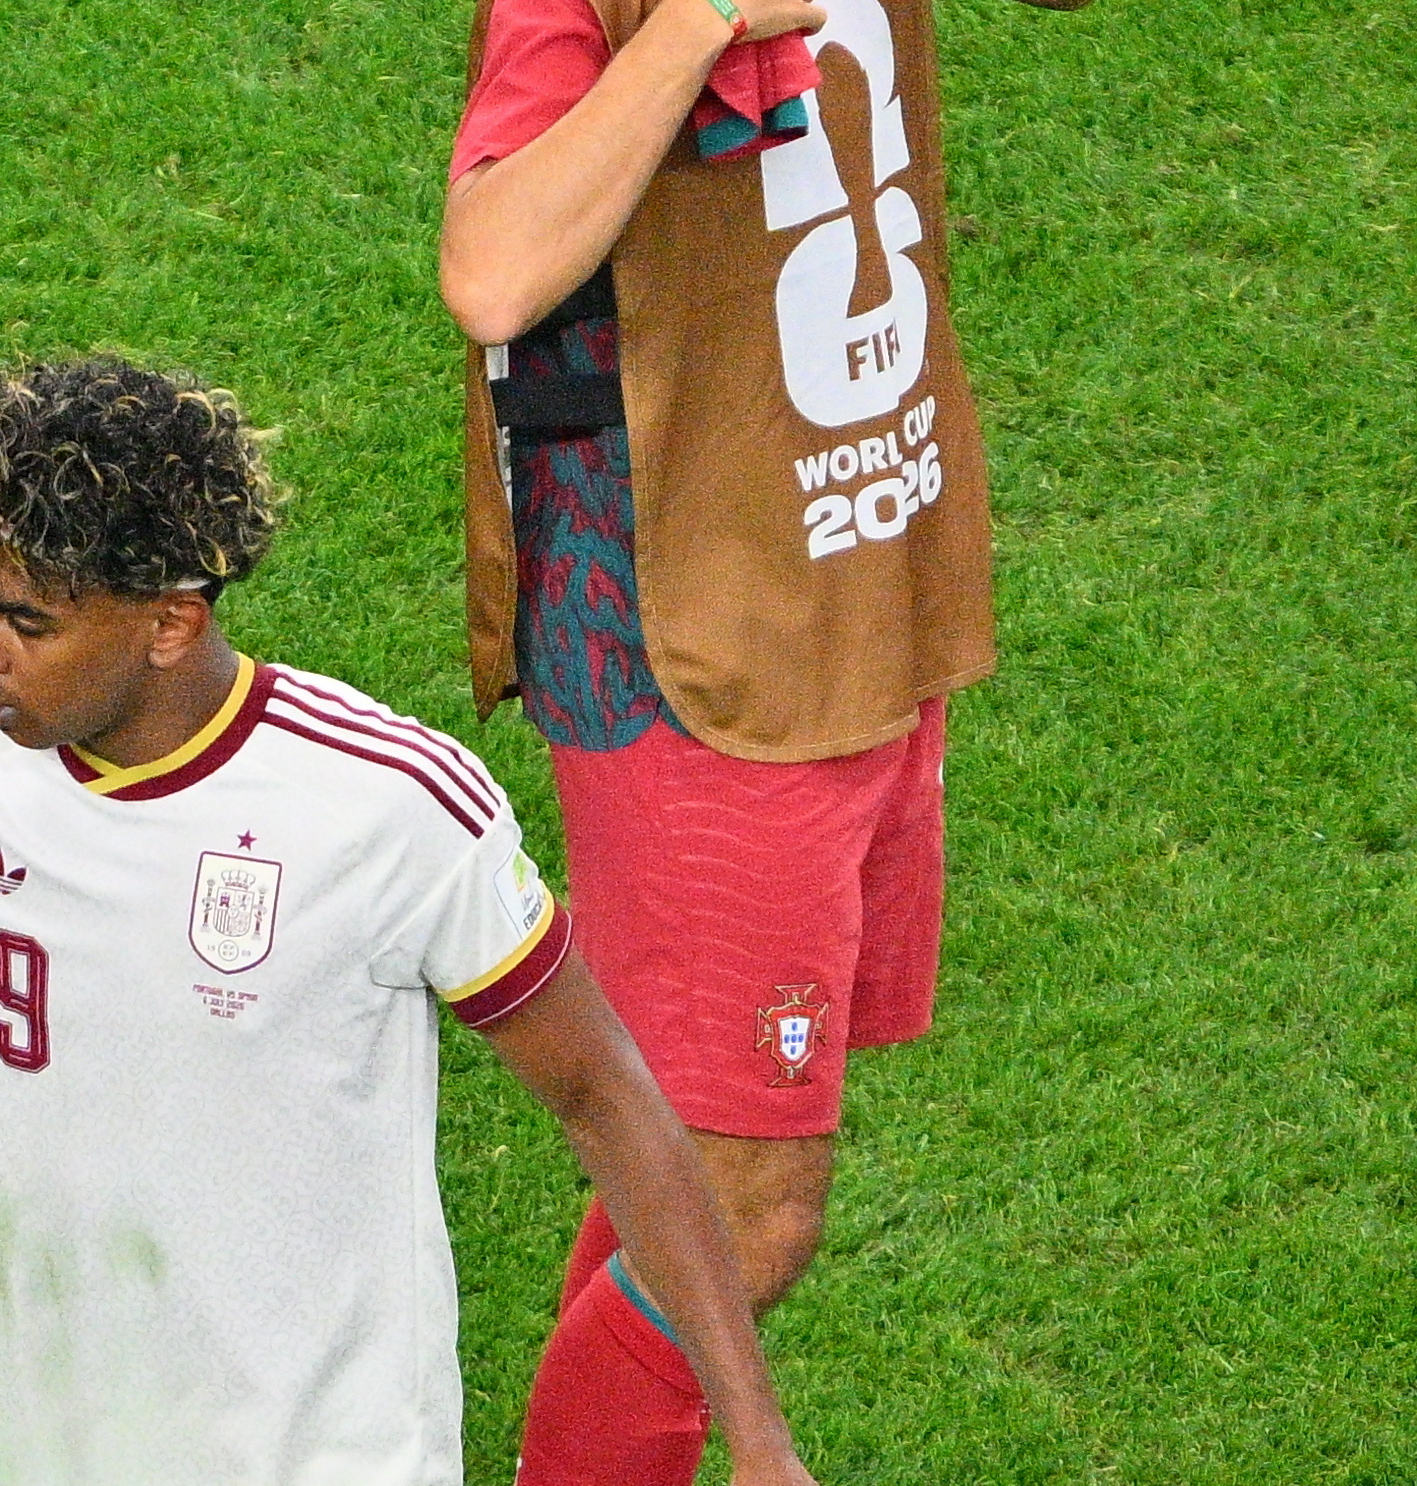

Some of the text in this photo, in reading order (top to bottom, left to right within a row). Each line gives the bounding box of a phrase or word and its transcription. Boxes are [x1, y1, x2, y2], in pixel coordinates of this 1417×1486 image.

[794, 395, 936, 491] WORL CUP
[803, 441, 942, 560] 2026
